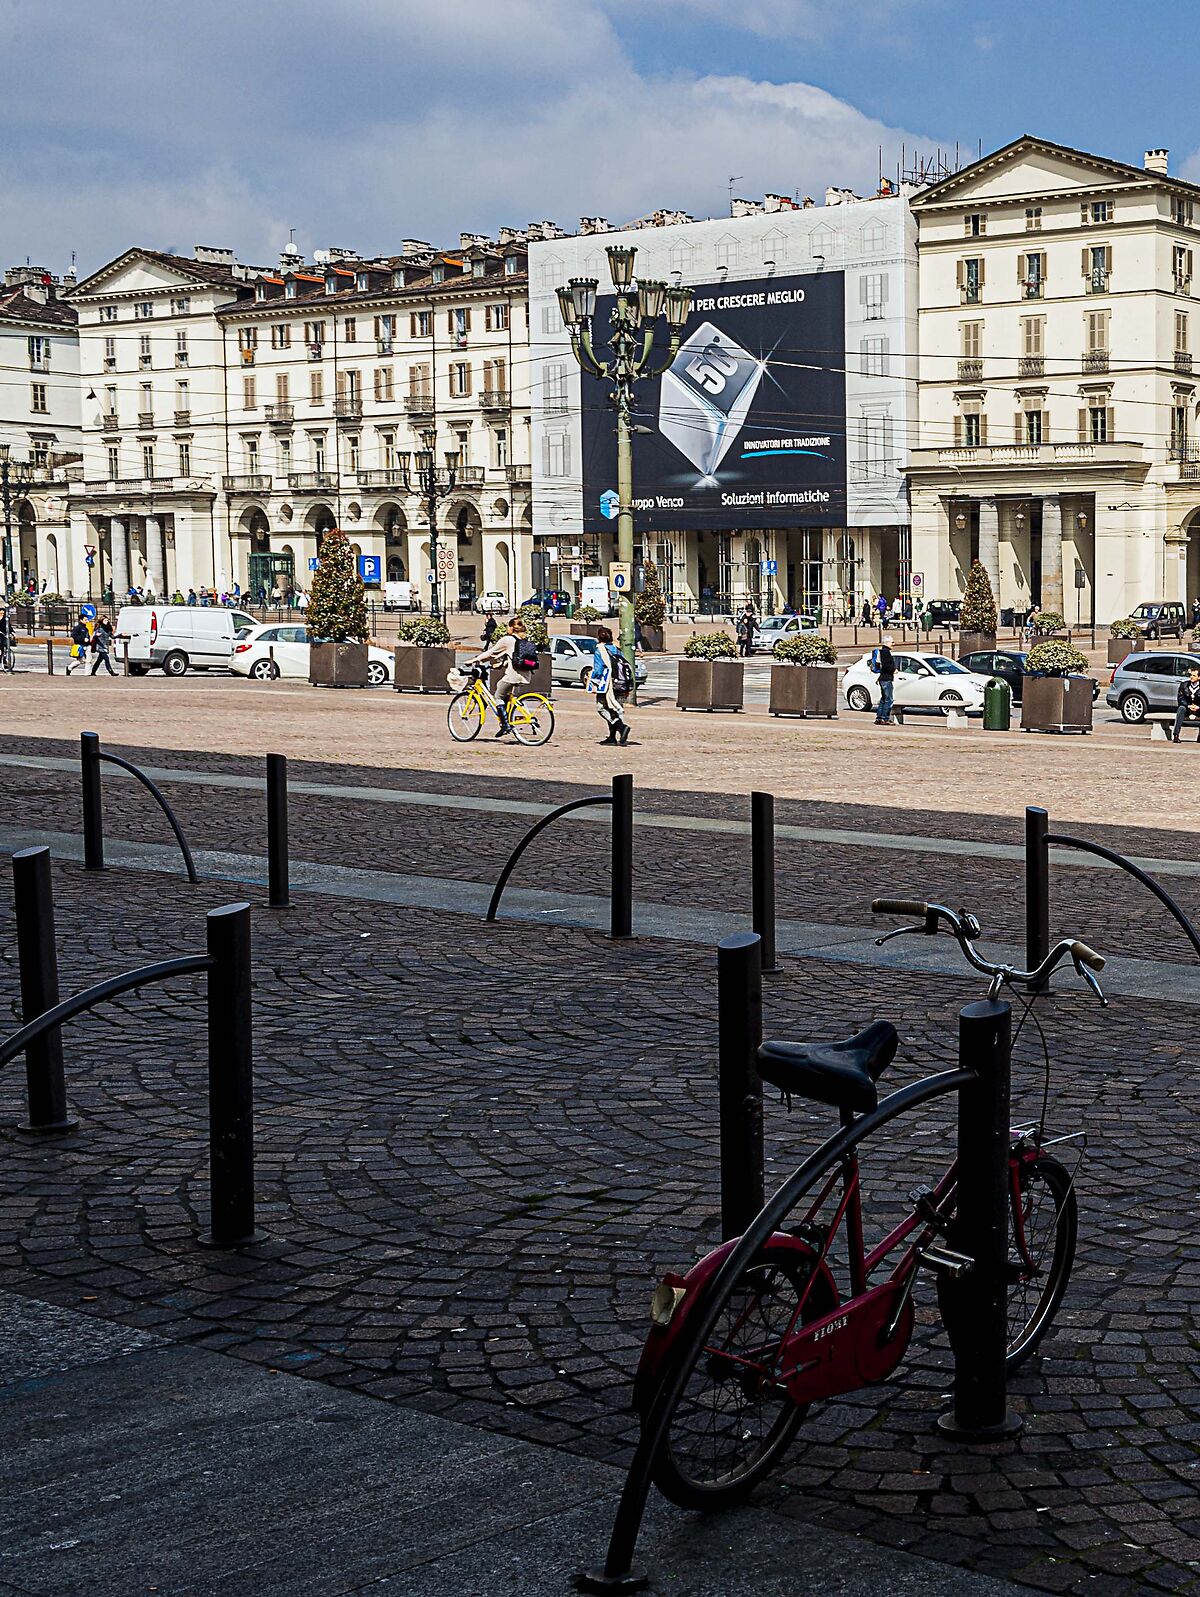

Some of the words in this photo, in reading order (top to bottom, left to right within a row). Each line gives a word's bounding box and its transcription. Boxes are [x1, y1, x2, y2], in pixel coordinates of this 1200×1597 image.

[697, 298, 716, 311] PER
[717, 293, 765, 309] CRESCERE
[766, 289, 805, 304] MEGLIO
[743, 440, 780, 449] INNOVATORI
[781, 438, 793, 448] PER
[793, 437, 831, 447] TRADIZIONE
[721, 492, 764, 505] Soluzioni
[766, 489, 830, 504] informatiche
[364, 561, 375, 576] P
